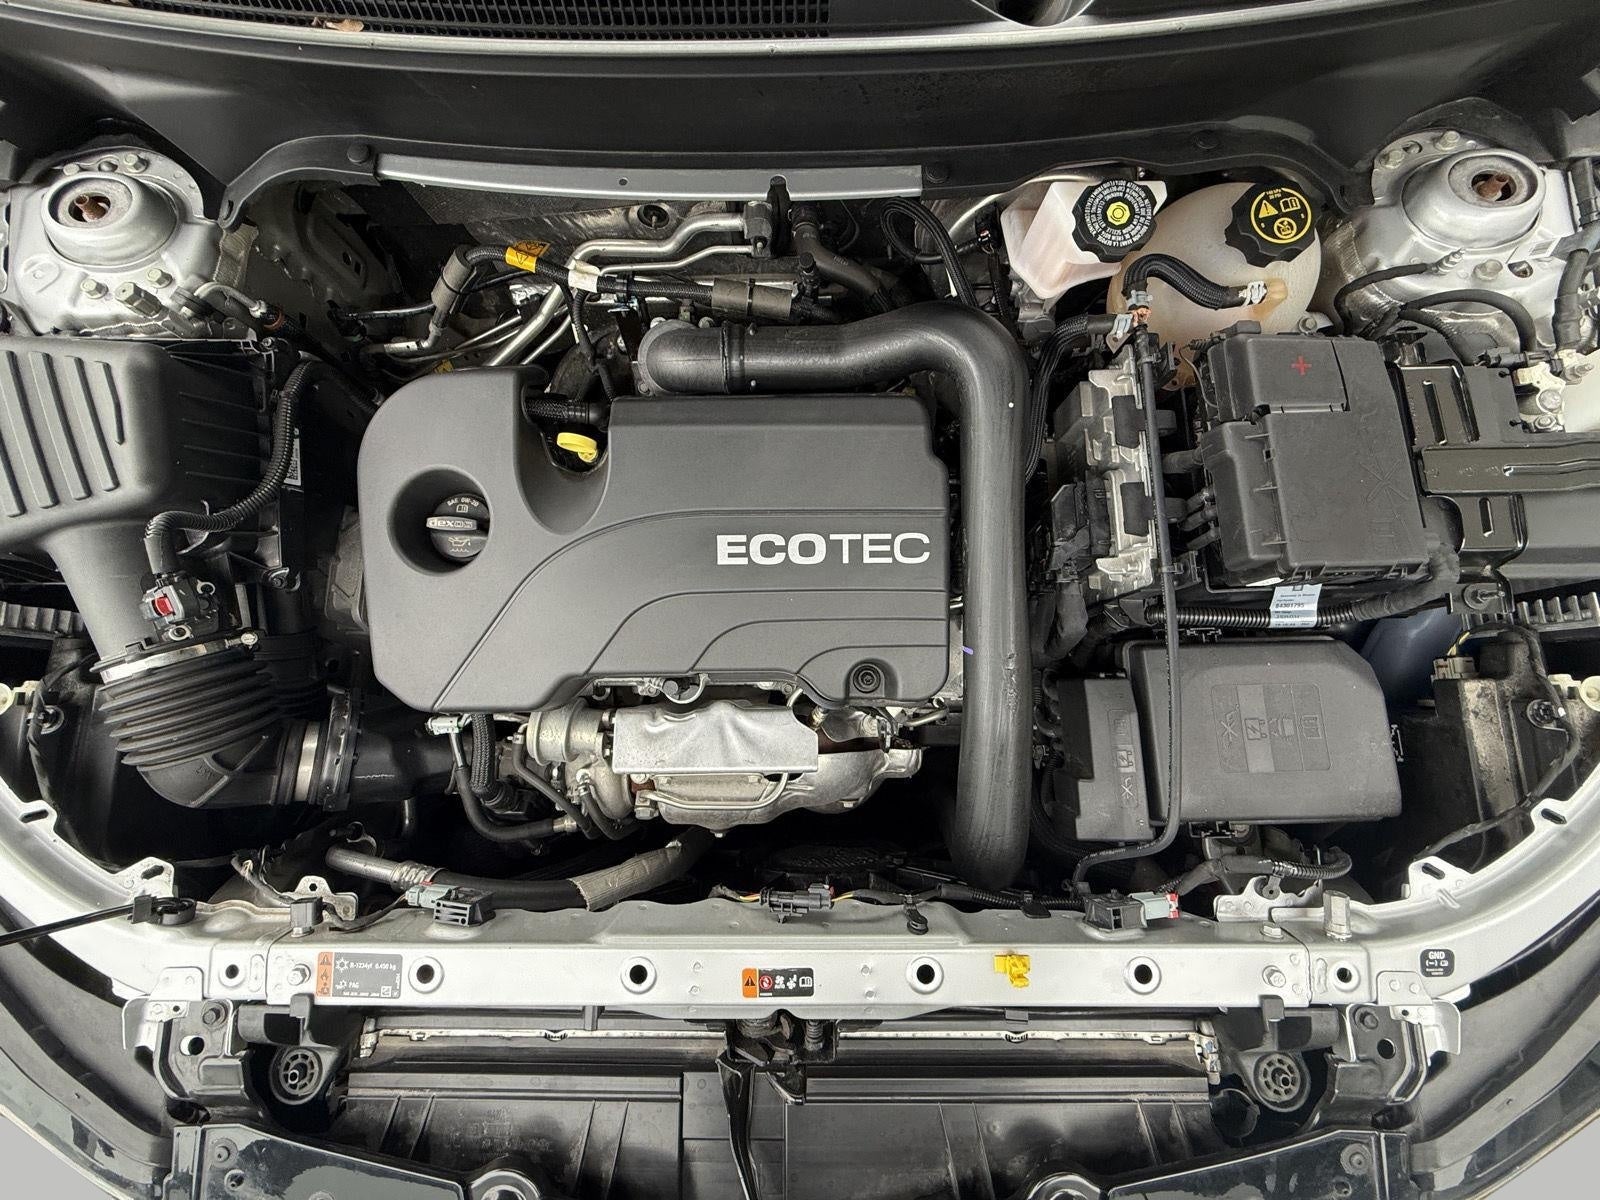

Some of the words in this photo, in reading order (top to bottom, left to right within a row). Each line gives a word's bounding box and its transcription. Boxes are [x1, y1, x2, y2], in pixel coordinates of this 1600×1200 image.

[429, 519, 473, 528] dexos
[716, 532, 931, 565] ECOTEC
[1429, 951, 1445, 959] GND
